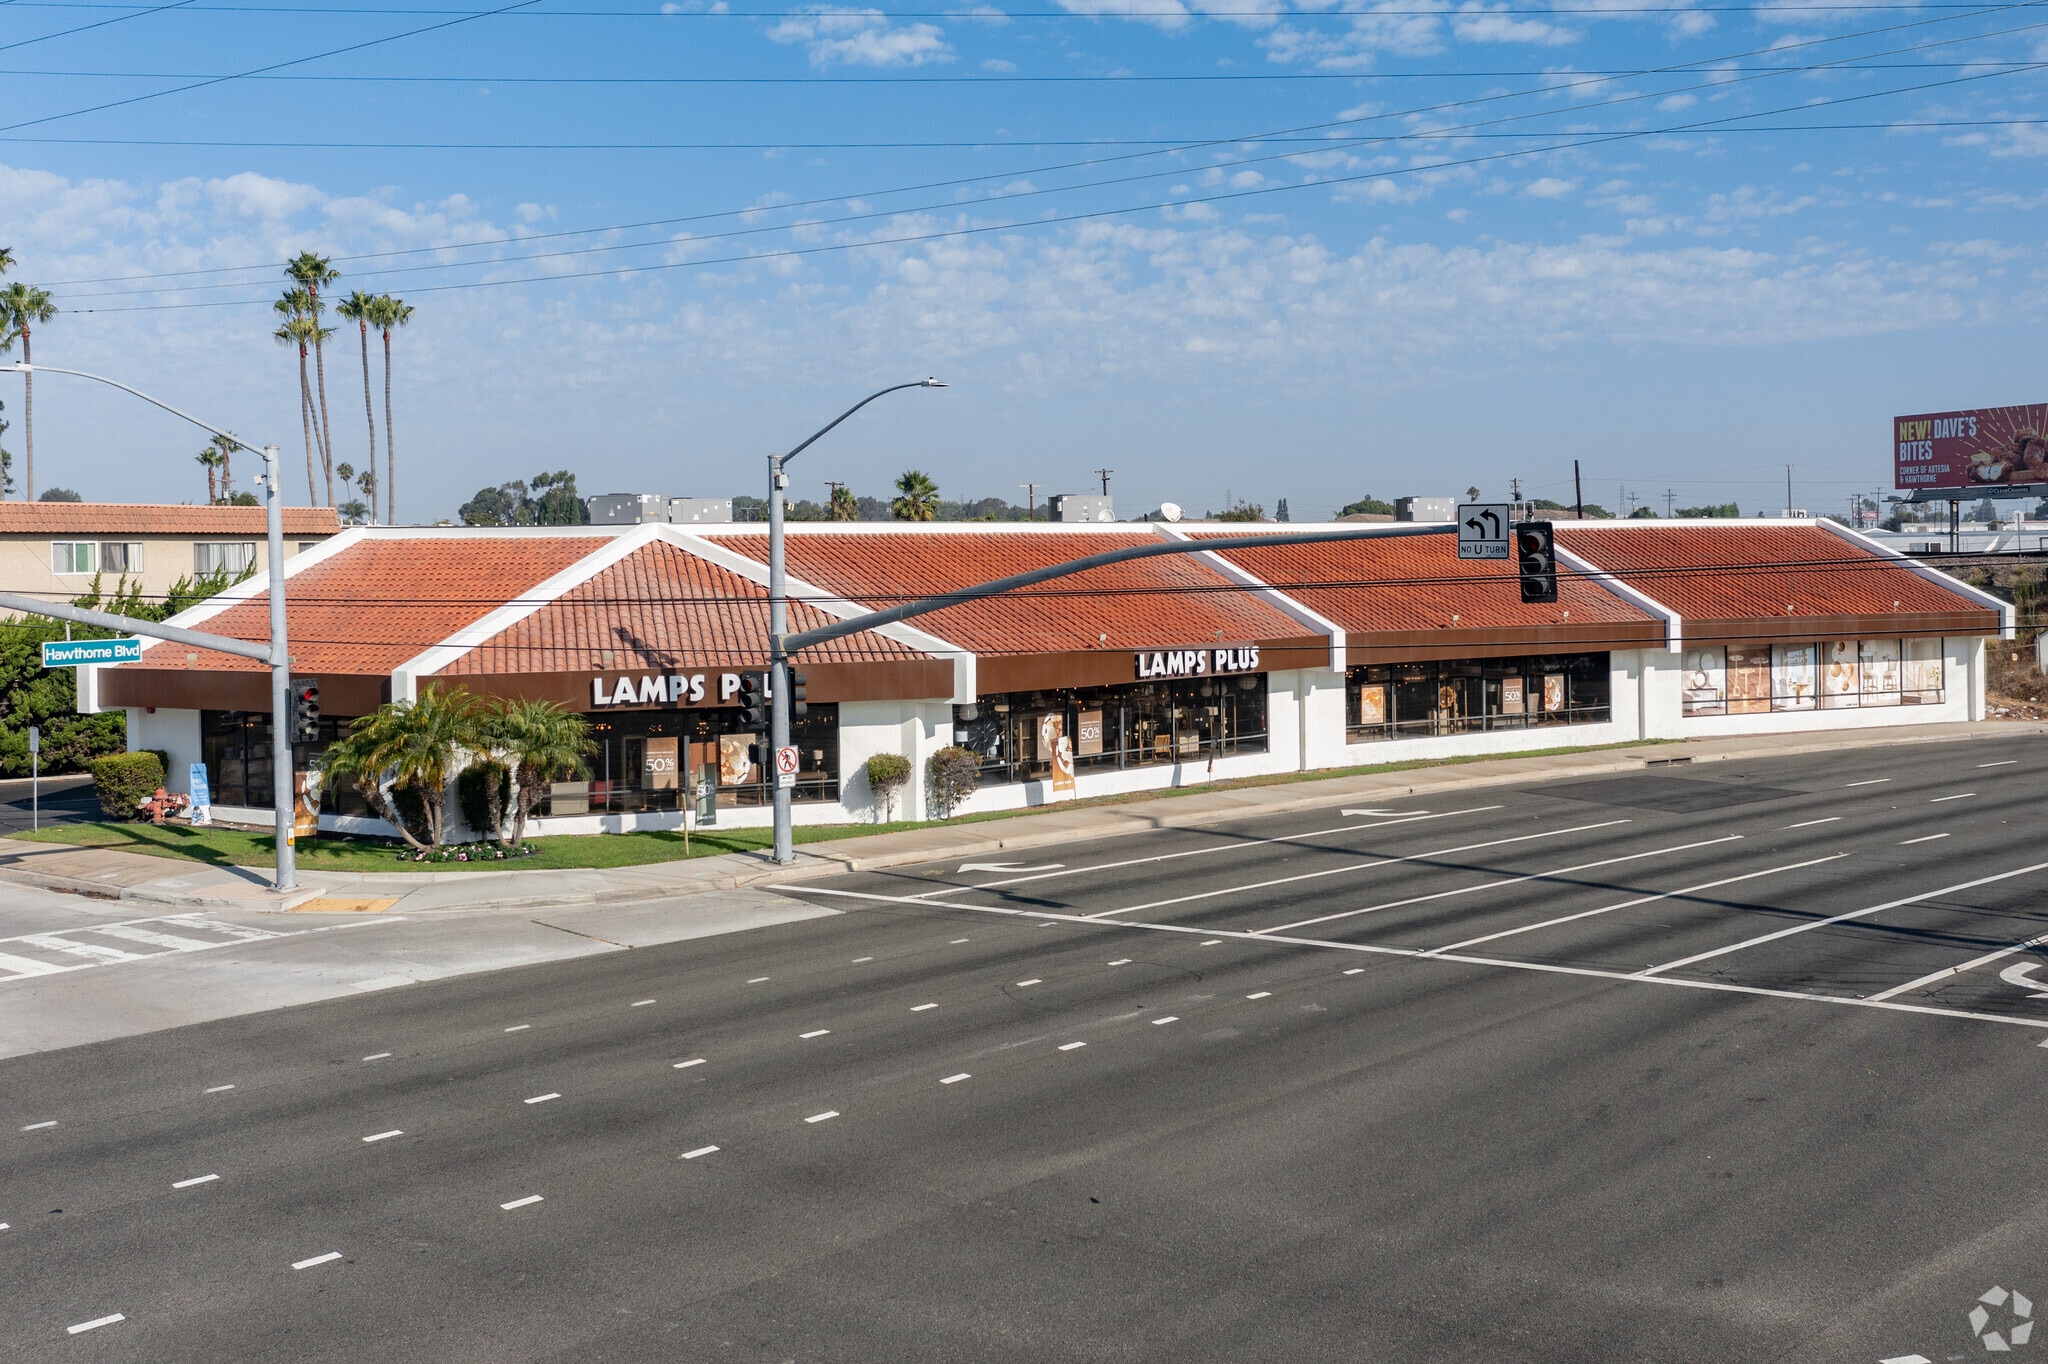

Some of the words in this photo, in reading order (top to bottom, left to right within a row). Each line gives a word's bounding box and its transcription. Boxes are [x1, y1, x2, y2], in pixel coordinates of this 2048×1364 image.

[1900, 421, 1931, 440] NEW!
[1934, 417, 1977, 438] DAVE'S
[1900, 441, 1932, 461] BITES
[1900, 466, 1919, 475] CORNER
[1920, 465, 1927, 473] OF
[1928, 464, 1950, 473] ARTESIA
[1905, 474, 1937, 483] HAWTHORNE
[1461, 546, 1471, 554] NO
[1474, 544, 1482, 555] U
[1485, 545, 1506, 554] TURN
[45, 647, 112, 660] Hawthorne
[115, 645, 140, 658] Blvd
[1140, 651, 1206, 676] LAMPS
[1215, 646, 1259, 671] PLUS
[594, 675, 705, 704] LAMPS
[1505, 691, 1520, 701] 50%
[1081, 727, 1100, 739] 50%
[645, 758, 675, 771] 50%
